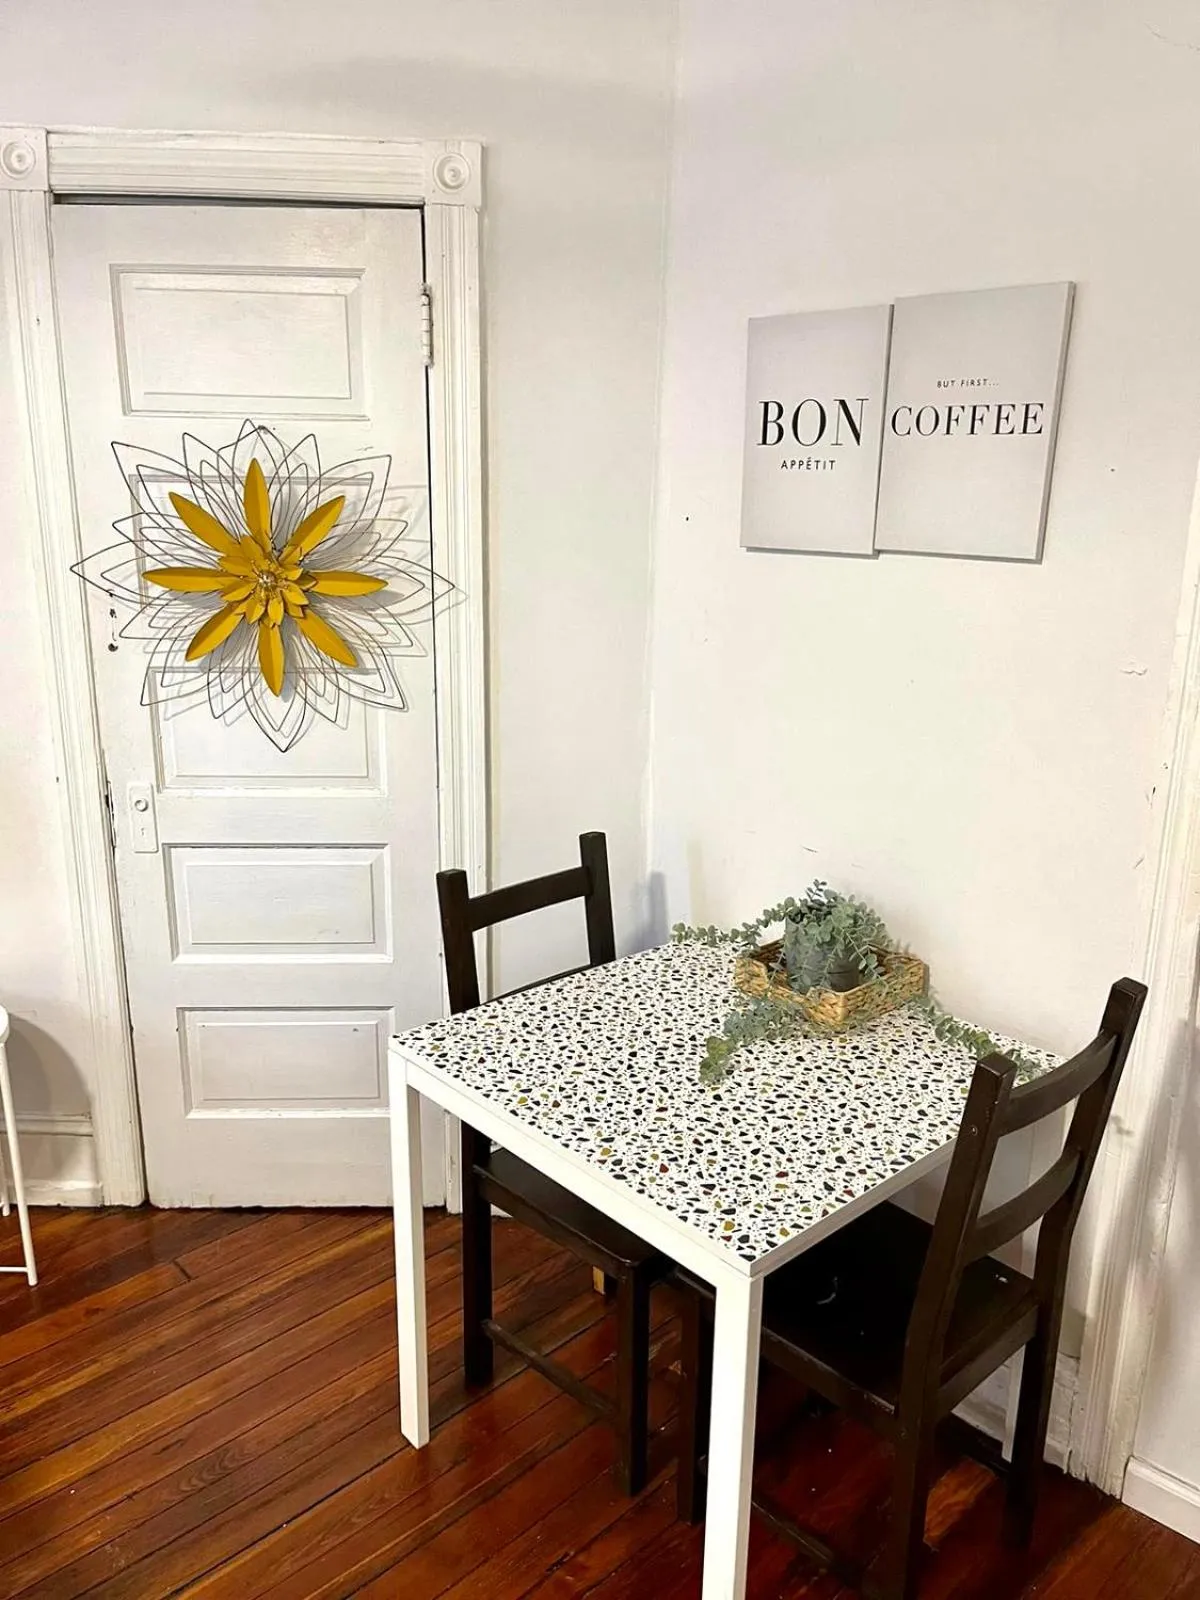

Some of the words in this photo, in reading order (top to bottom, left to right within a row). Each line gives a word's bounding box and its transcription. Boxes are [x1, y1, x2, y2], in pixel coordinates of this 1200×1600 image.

[937, 379, 955, 388] BUT
[960, 378, 1000, 388] FIRST...
[756, 398, 869, 447] BON
[891, 403, 1044, 437] COFFEE
[780, 457, 836, 470] APPÉTIT
